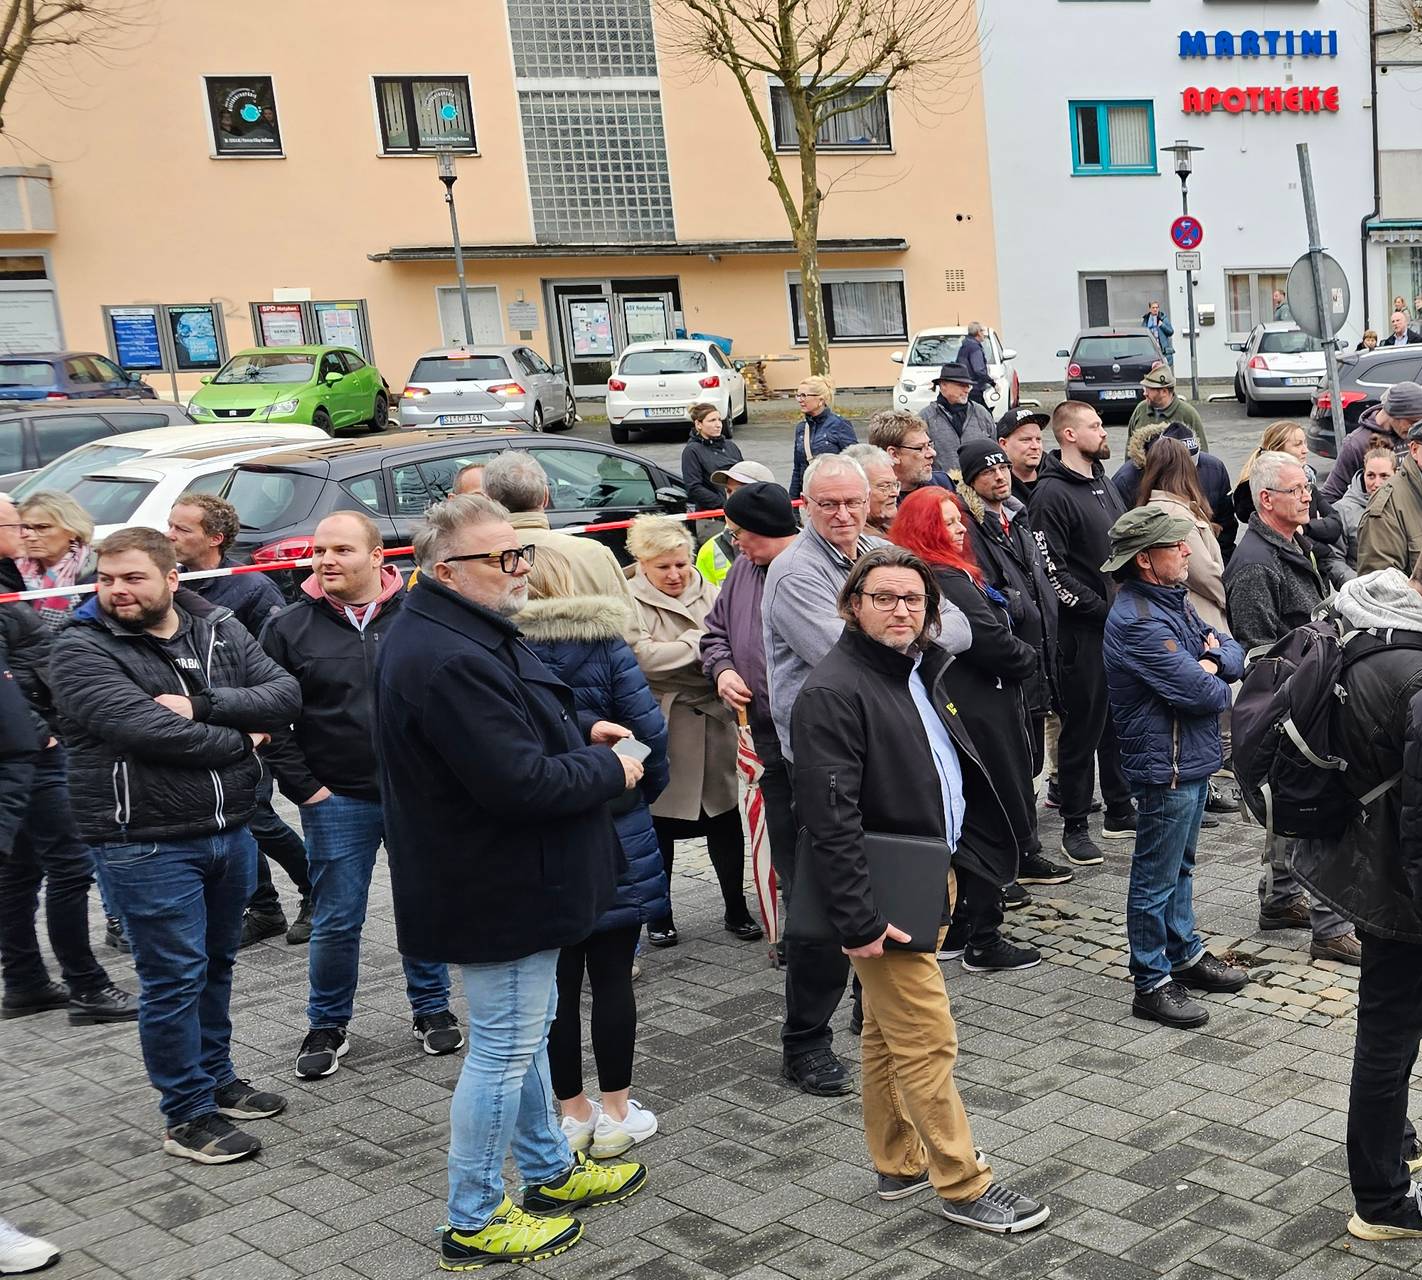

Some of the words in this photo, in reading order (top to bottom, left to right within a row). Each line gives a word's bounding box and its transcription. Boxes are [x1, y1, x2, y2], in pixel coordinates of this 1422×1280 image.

[1180, 30, 1338, 57] MARTINI
[1183, 86, 1339, 112] APOTHEKE
[984, 453, 1005, 467] NY
